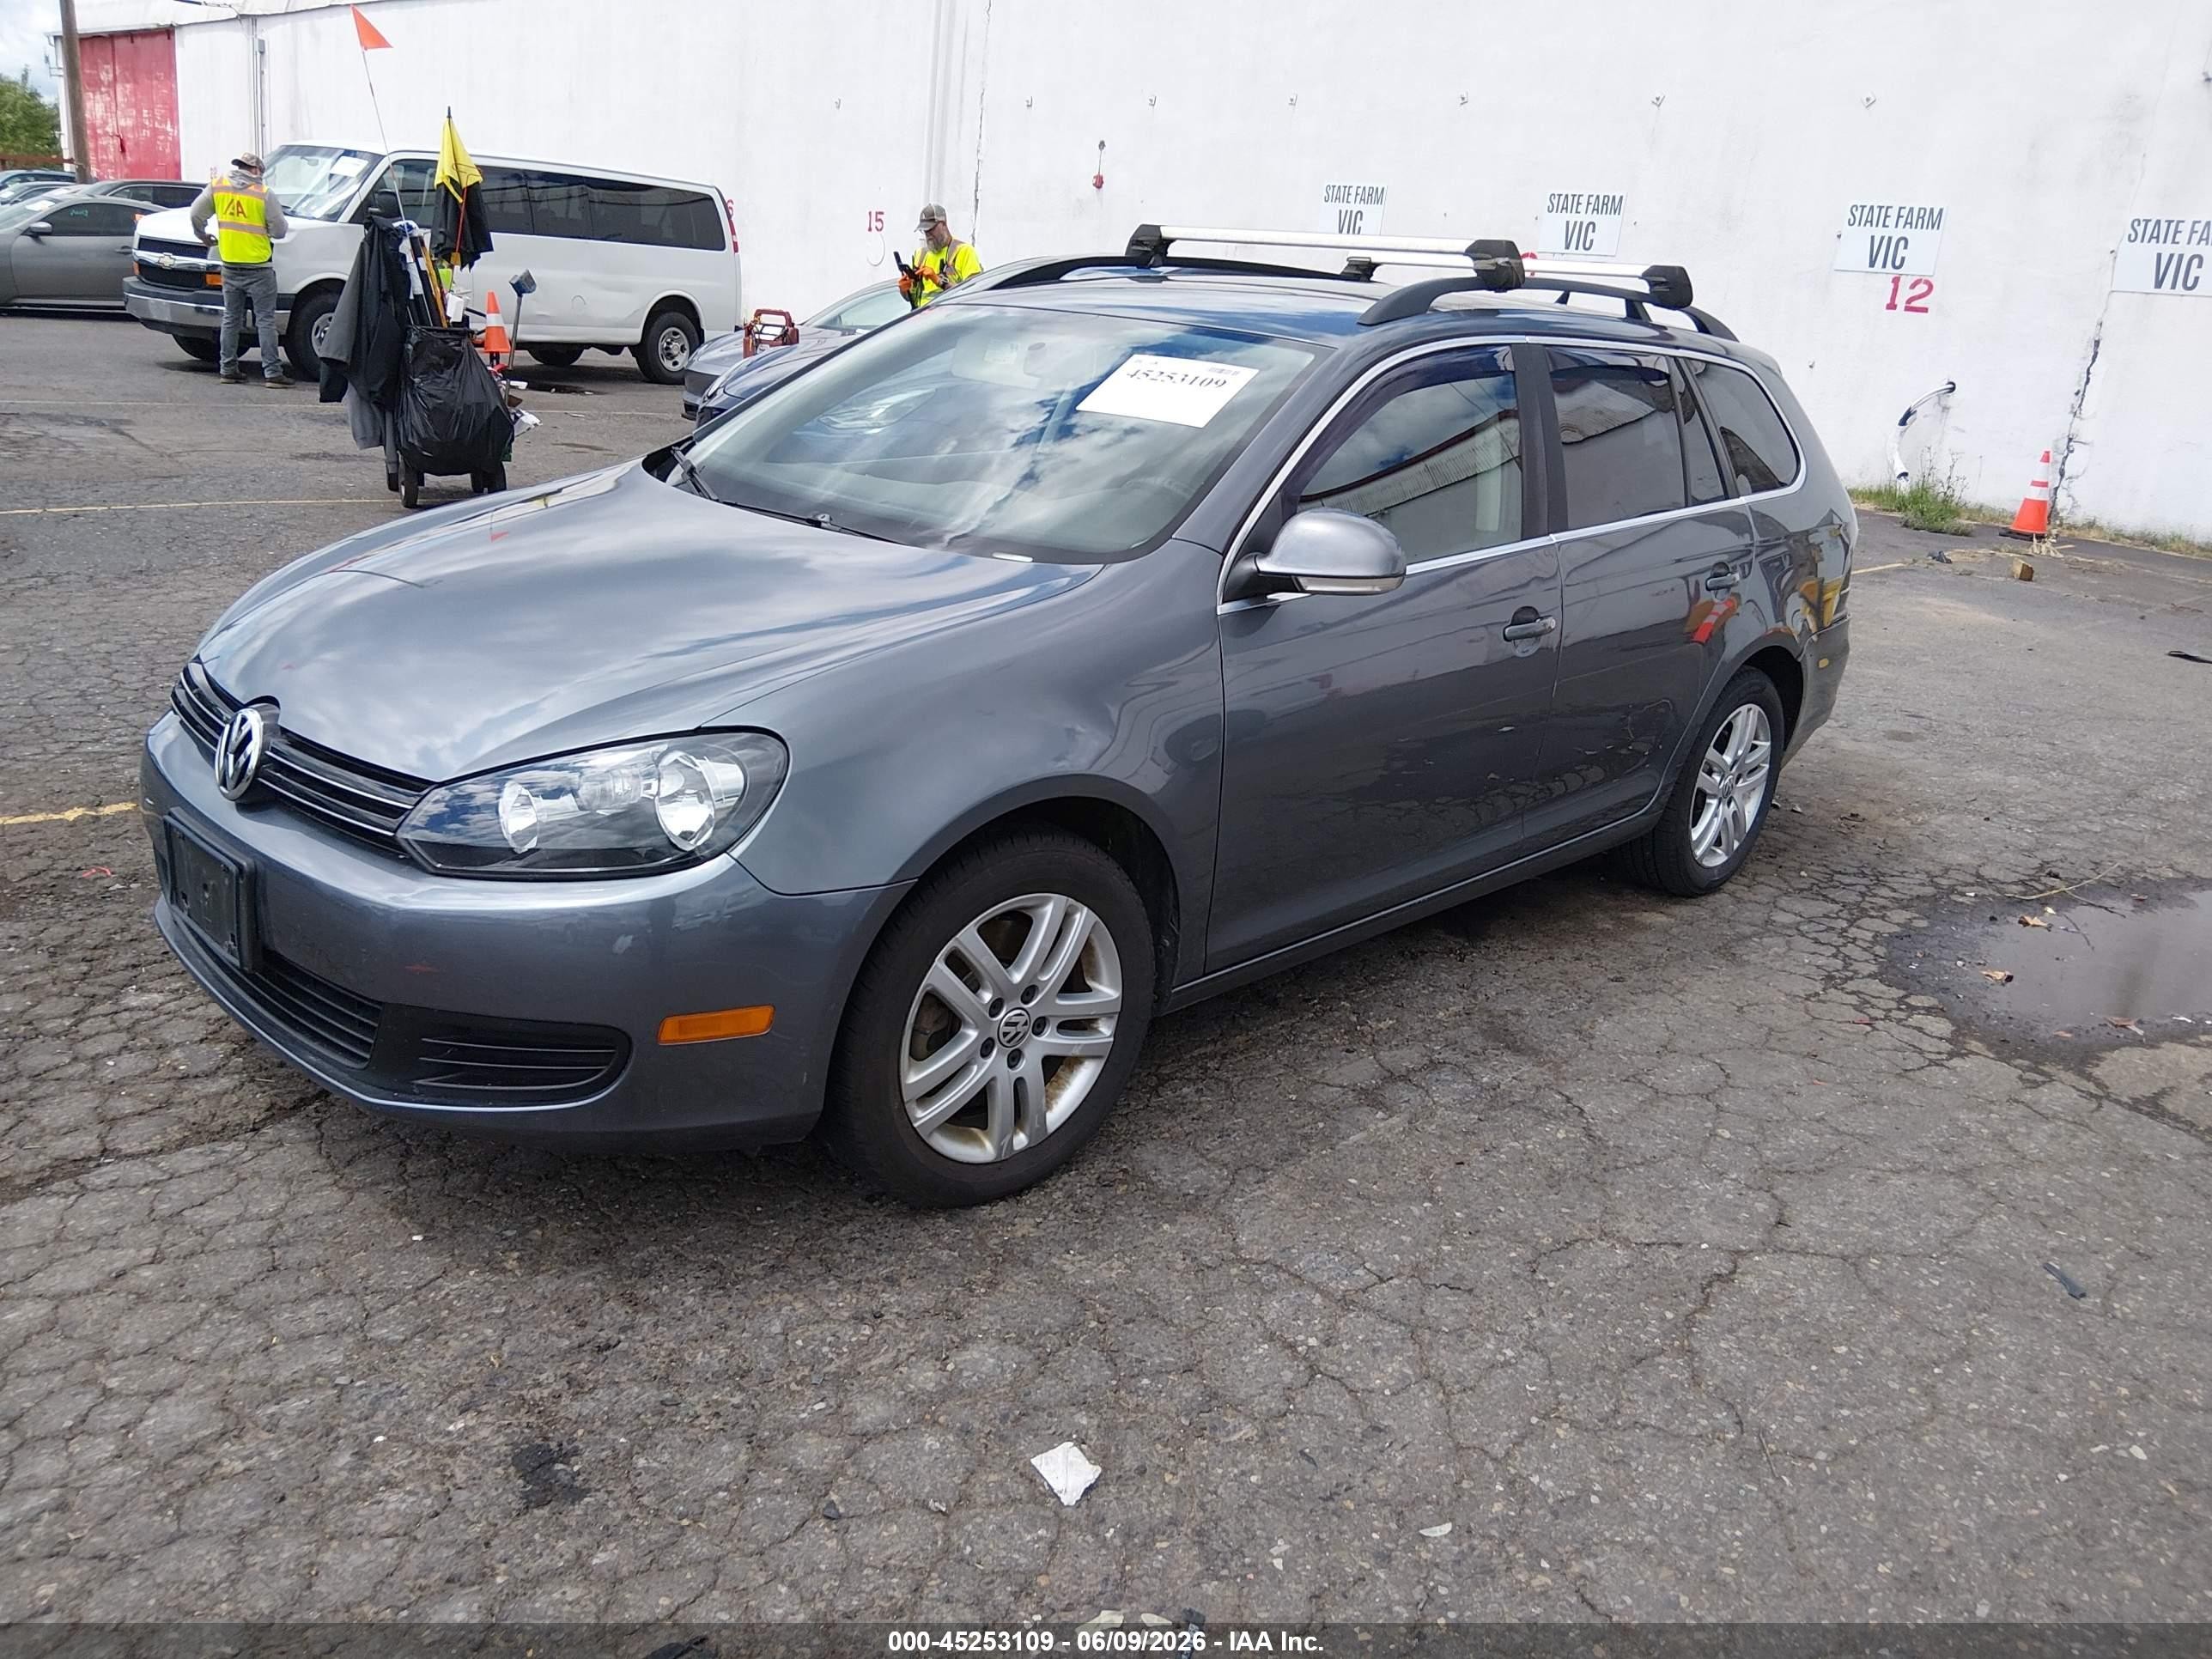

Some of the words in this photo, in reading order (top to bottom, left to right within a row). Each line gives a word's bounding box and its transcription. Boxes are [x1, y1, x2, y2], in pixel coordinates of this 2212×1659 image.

[1324, 185, 1353, 204] STATE
[1354, 185, 1385, 205] FARM
[1547, 193, 1583, 214] STATE
[1585, 194, 1624, 216] FARM
[867, 211, 884, 232] 15
[1338, 209, 1364, 234] VIC
[1848, 204, 1893, 228] STATE
[1894, 206, 1944, 231] FARM
[1565, 220, 1596, 251] VIC
[2127, 218, 2185, 245] STATE
[2186, 220, 2212, 246] FA
[1869, 234, 1909, 270] VIC
[2154, 252, 2204, 291] VIC
[1886, 276, 1934, 313] 12
[1127, 368, 1227, 388] 45253109
